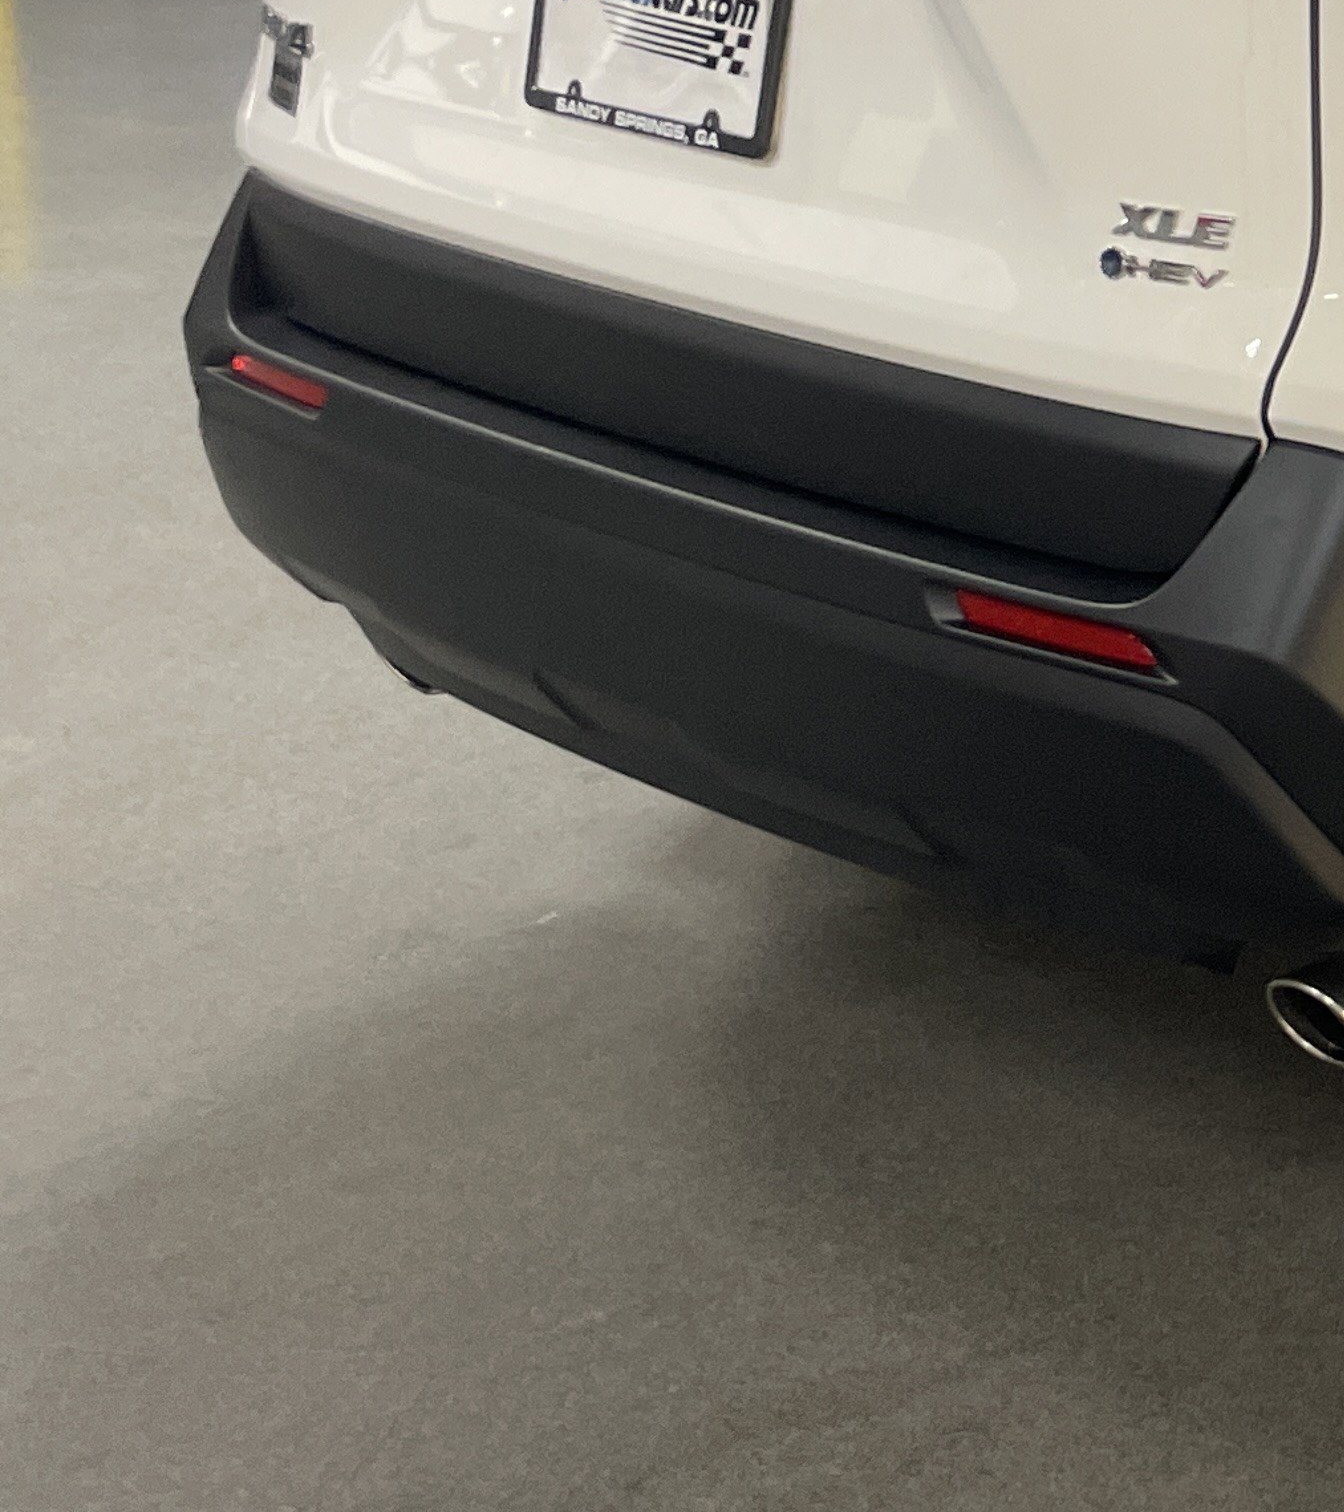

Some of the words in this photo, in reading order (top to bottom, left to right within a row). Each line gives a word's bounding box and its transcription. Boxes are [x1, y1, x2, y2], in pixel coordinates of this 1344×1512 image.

[555, 97, 611, 123] SANDY
[615, 110, 689, 144] SPRINGS,
[695, 128, 719, 148] GA
[1112, 202, 1236, 250] XLE
